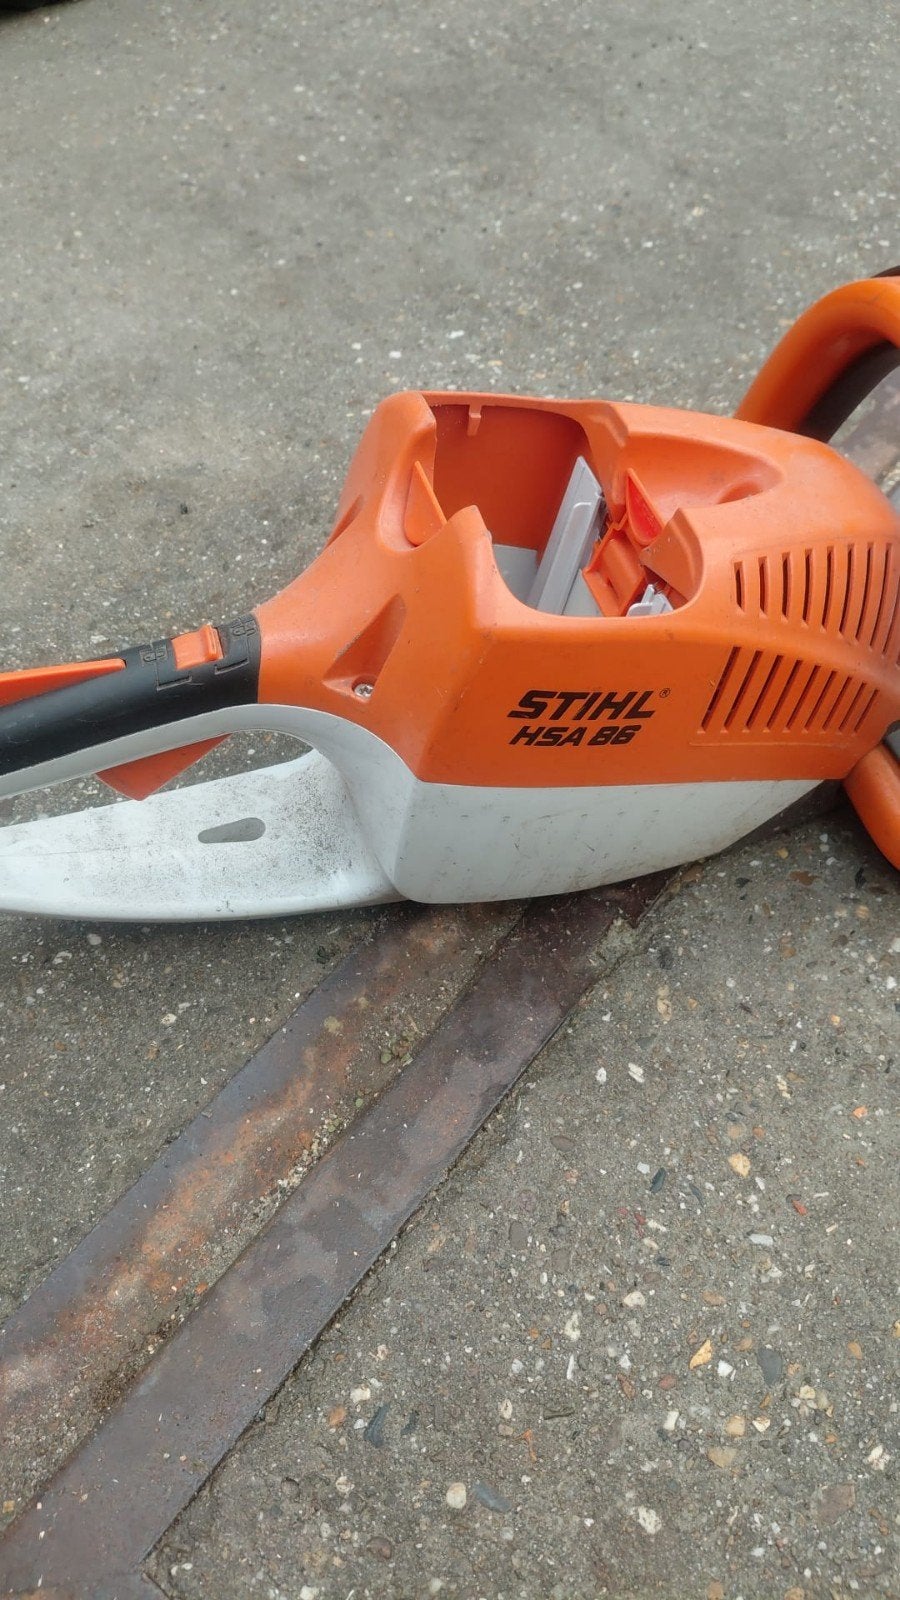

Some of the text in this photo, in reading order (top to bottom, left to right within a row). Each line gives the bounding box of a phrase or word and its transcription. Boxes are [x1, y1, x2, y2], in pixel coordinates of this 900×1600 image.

[507, 690, 656, 720] STIHL
[508, 724, 642, 746] HSA 86
